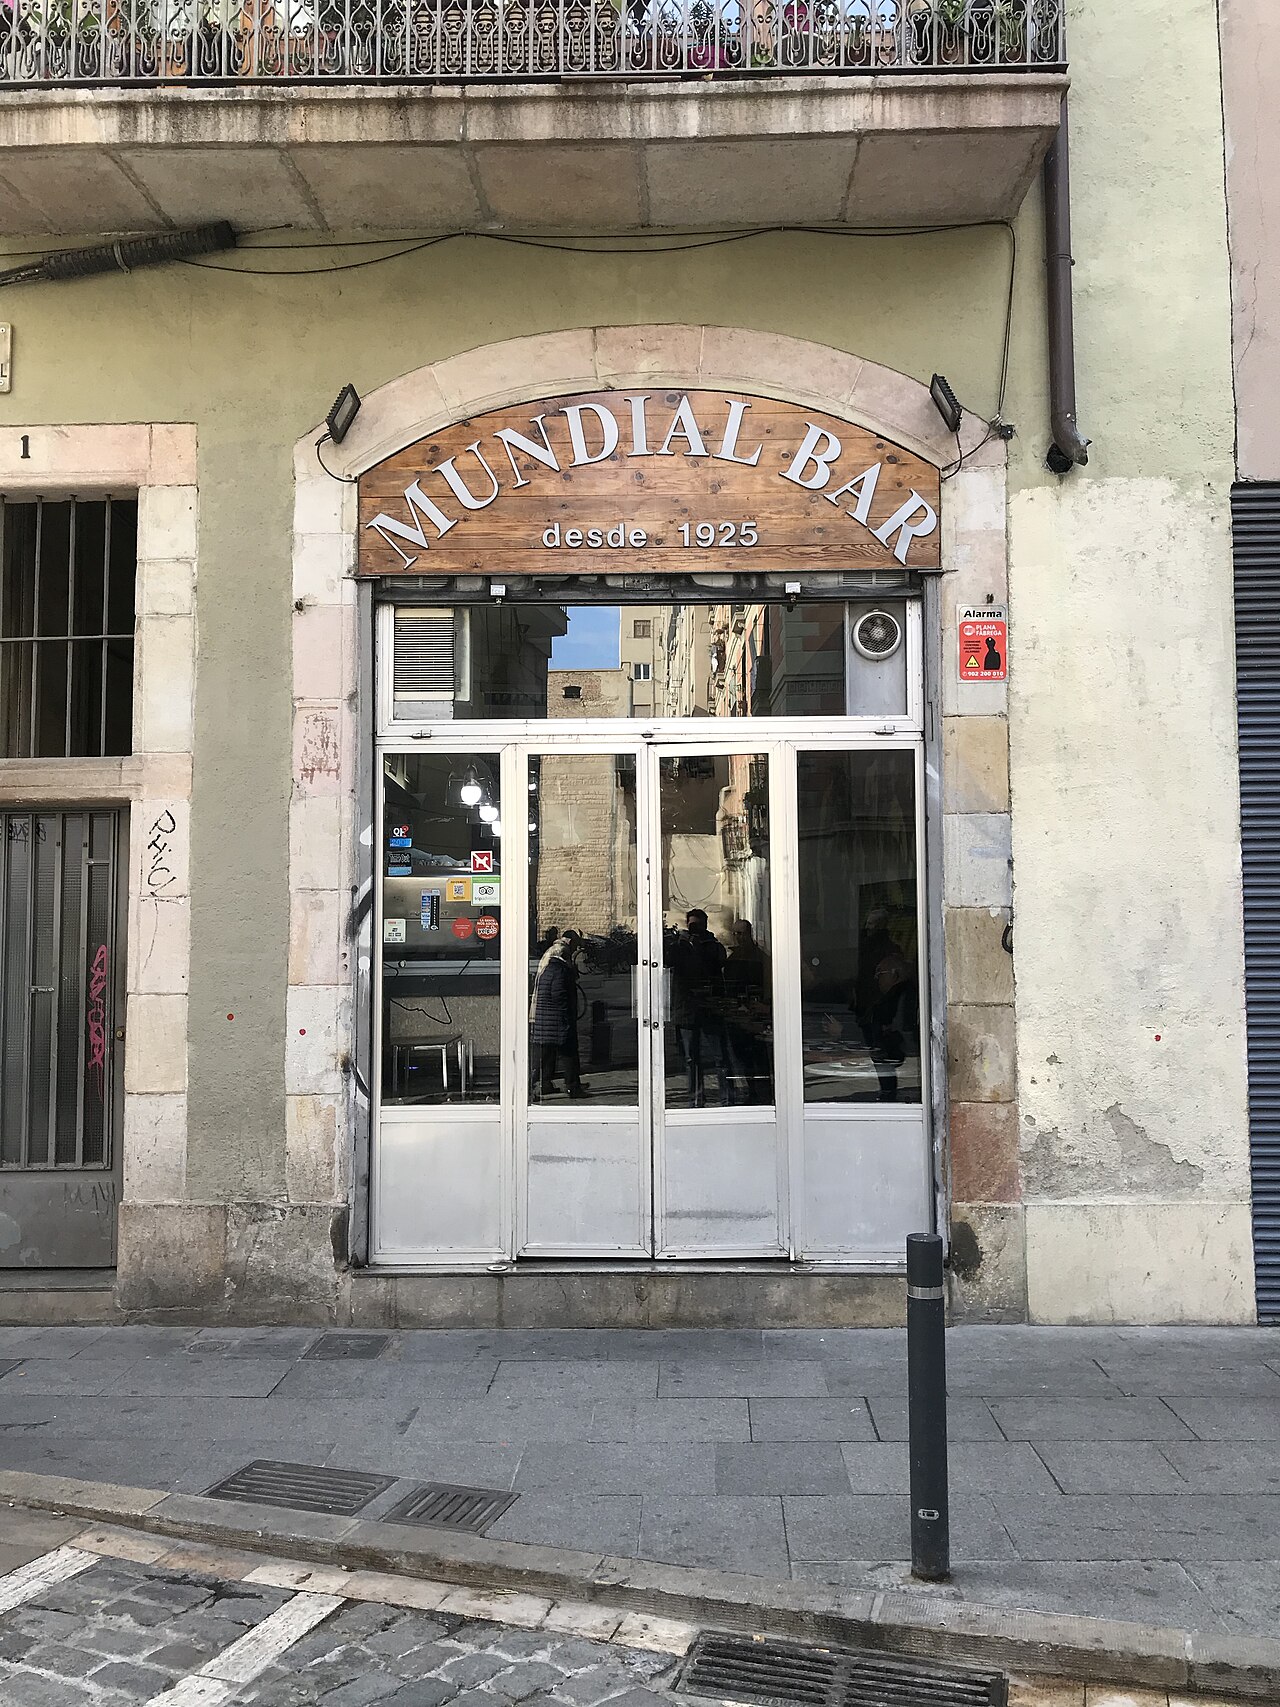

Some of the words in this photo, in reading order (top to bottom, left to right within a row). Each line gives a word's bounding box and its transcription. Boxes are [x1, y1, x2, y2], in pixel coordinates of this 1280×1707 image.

[20, 434, 31, 459] 1
[365, 394, 764, 570] MUNDIAL
[778, 421, 938, 567] BAR
[541, 522, 647, 549] desde
[676, 521, 759, 548] 1925
[963, 610, 1003, 618] Alarma
